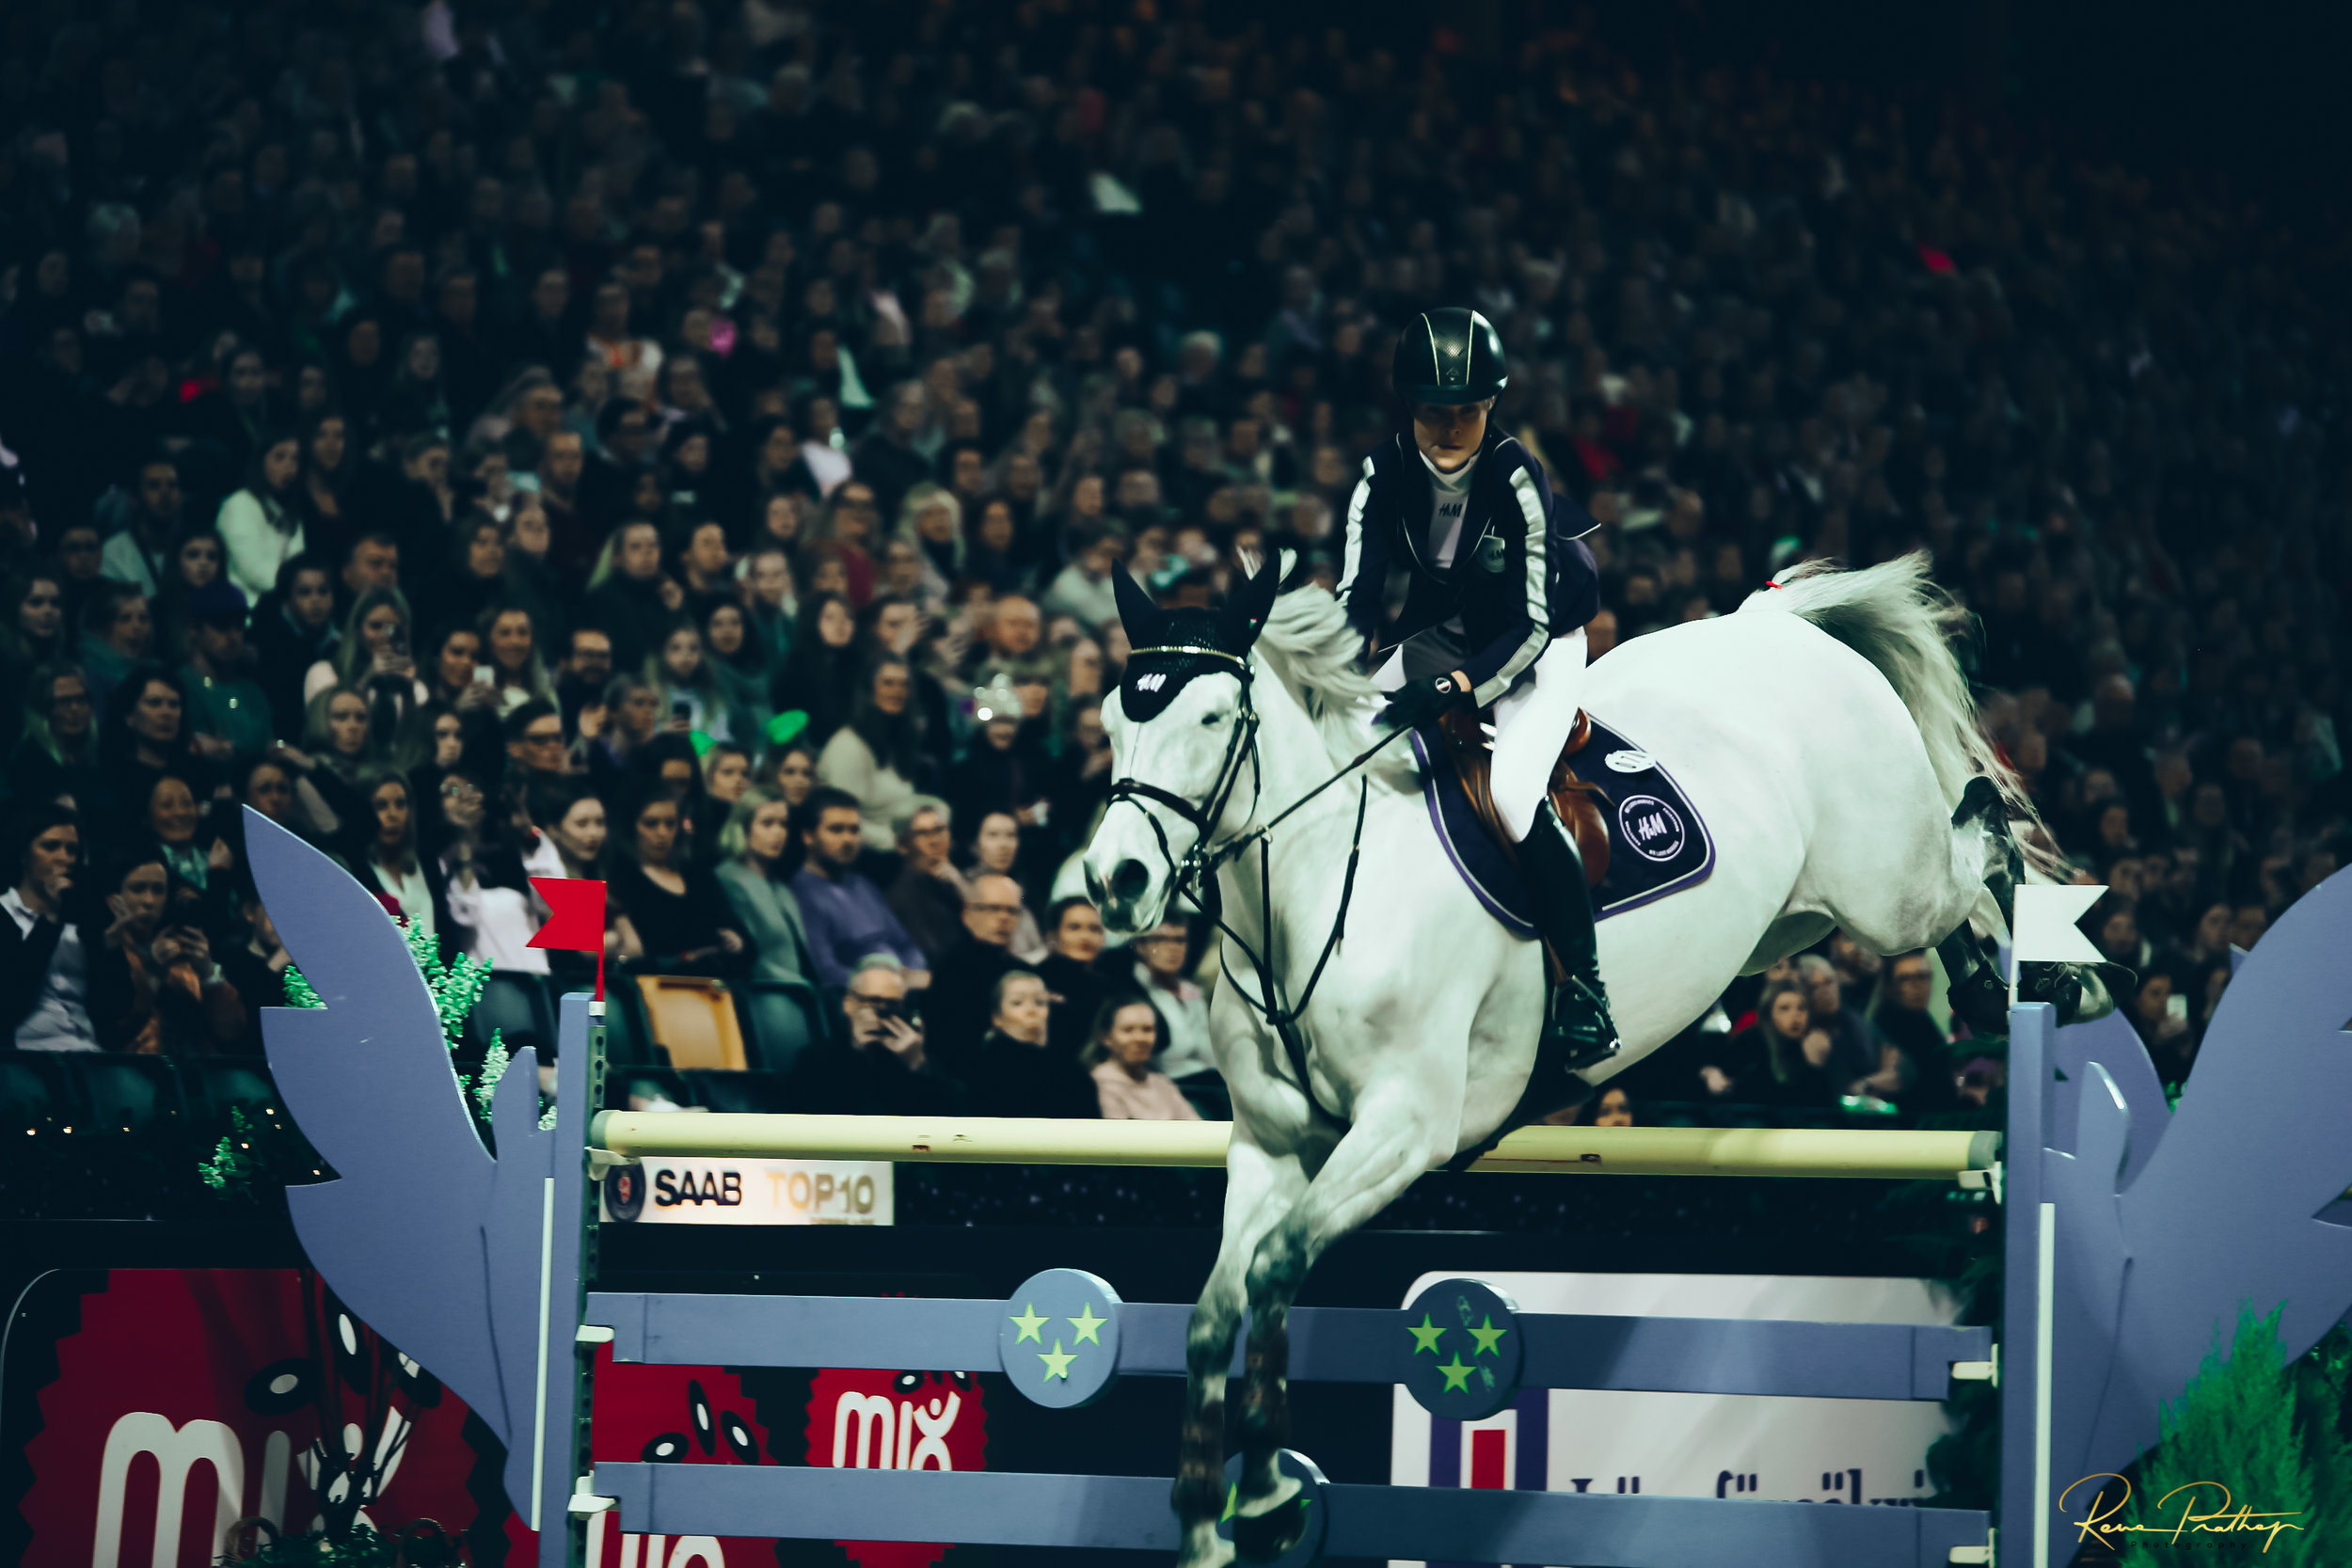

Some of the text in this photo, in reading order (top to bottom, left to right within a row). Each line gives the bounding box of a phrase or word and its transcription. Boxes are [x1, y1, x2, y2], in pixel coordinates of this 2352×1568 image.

[1638, 812, 1667, 841] H&M
[655, 1169, 741, 1206] SAAB
[833, 1390, 961, 1471] mix
